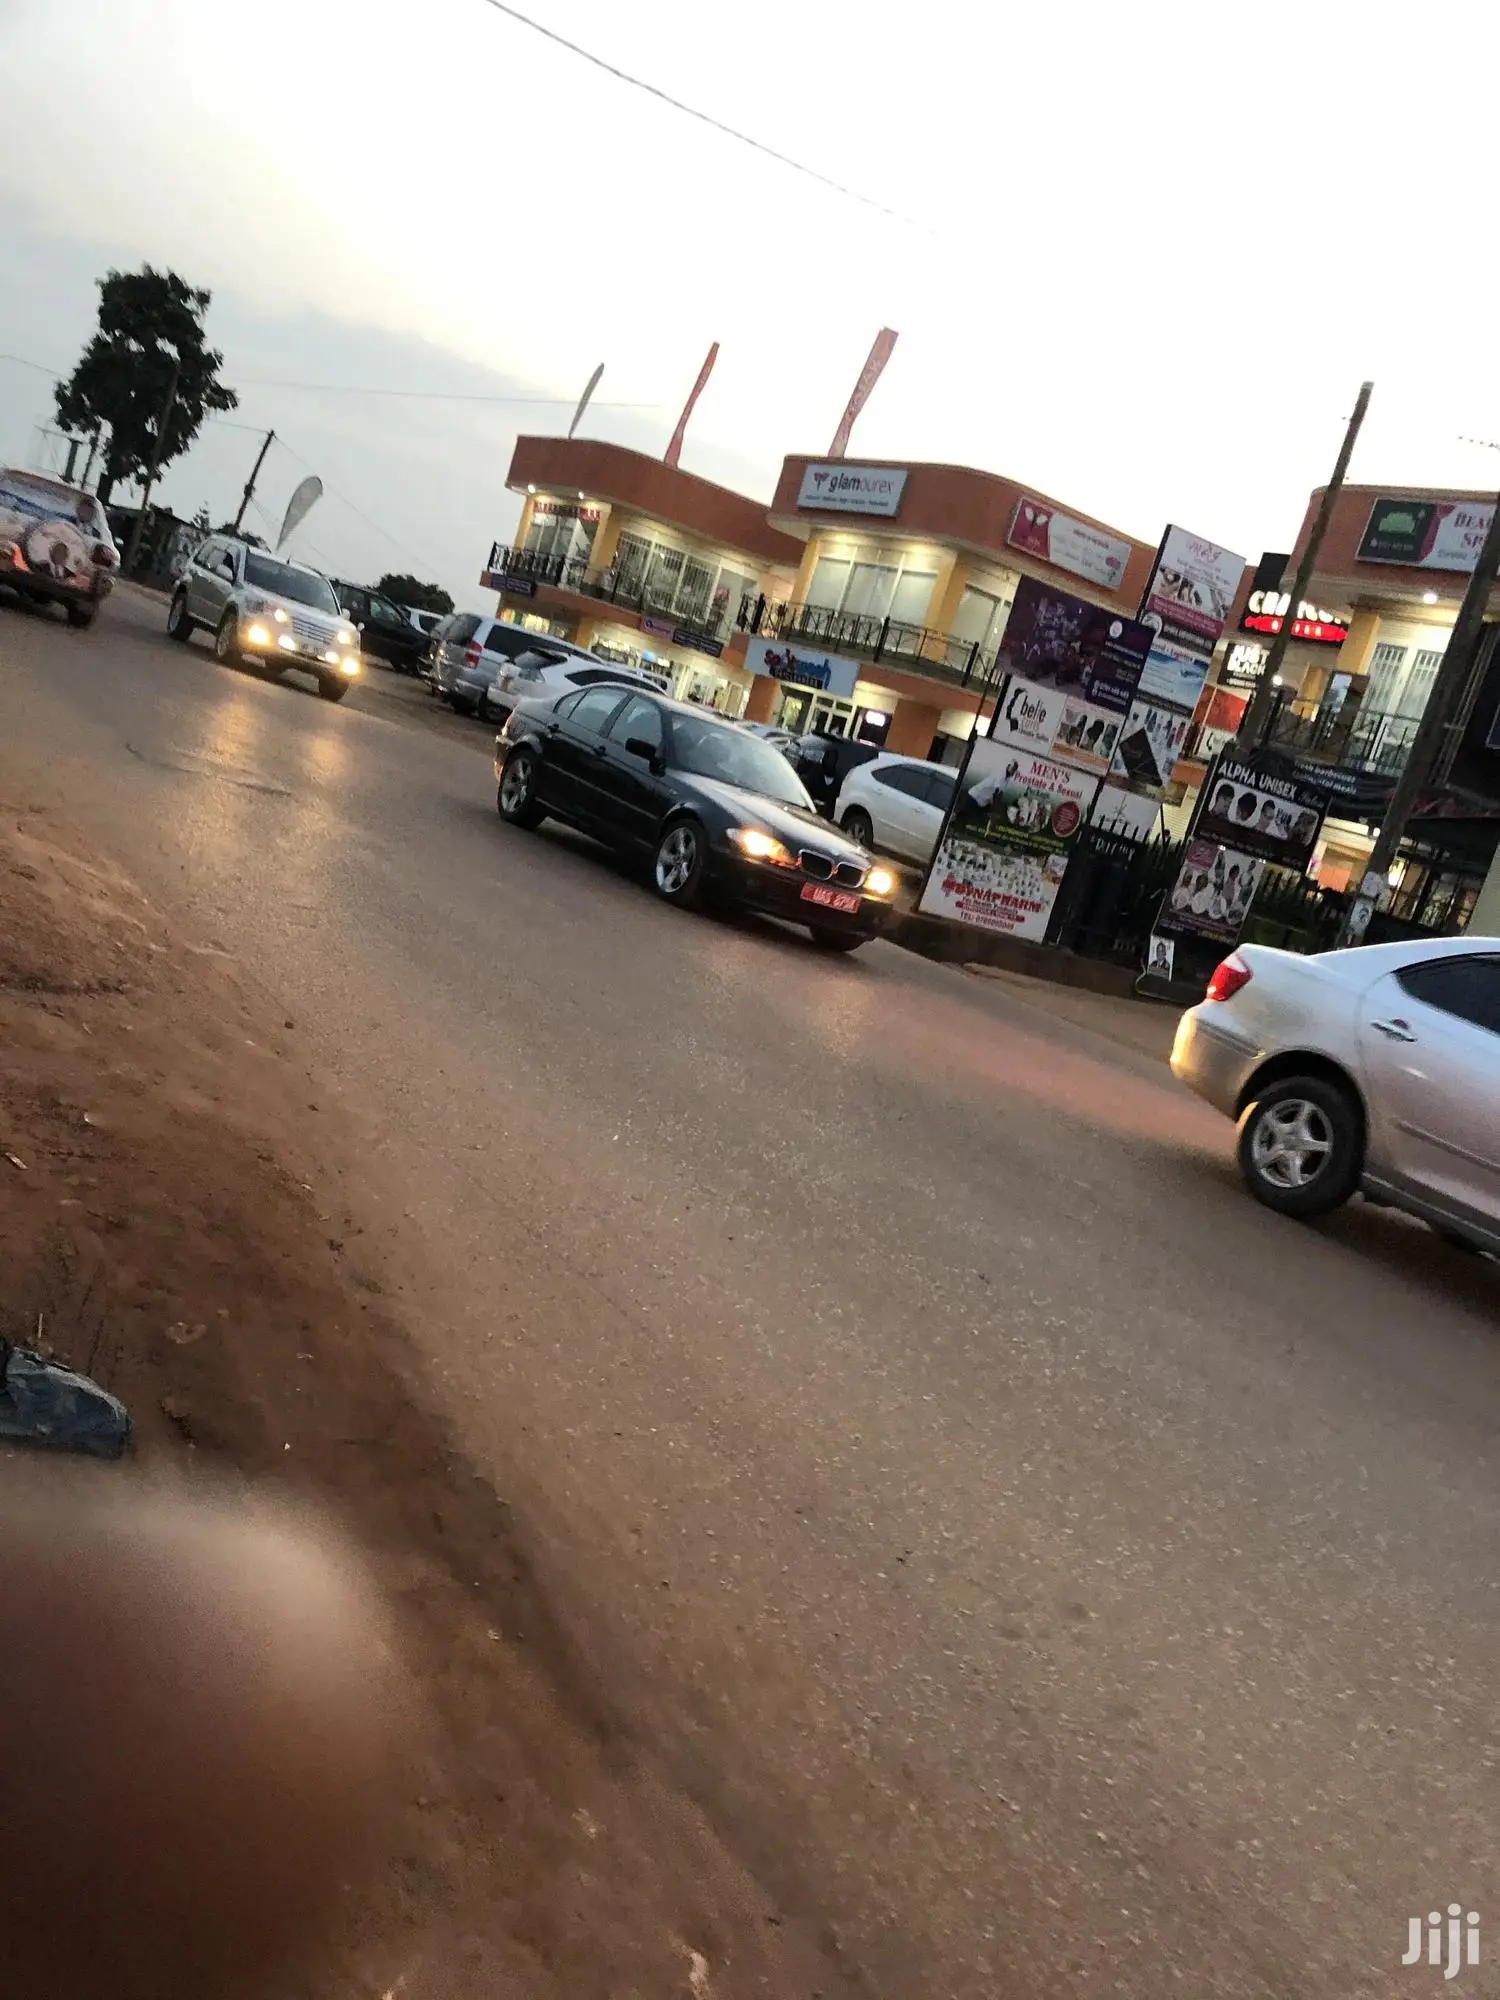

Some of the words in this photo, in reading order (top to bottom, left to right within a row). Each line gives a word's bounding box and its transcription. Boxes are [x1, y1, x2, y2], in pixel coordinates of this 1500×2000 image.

[1030, 761, 1071, 784] MEN'S
[1218, 761, 1257, 789] ALPHA
[1259, 773, 1297, 800] UNISEX
